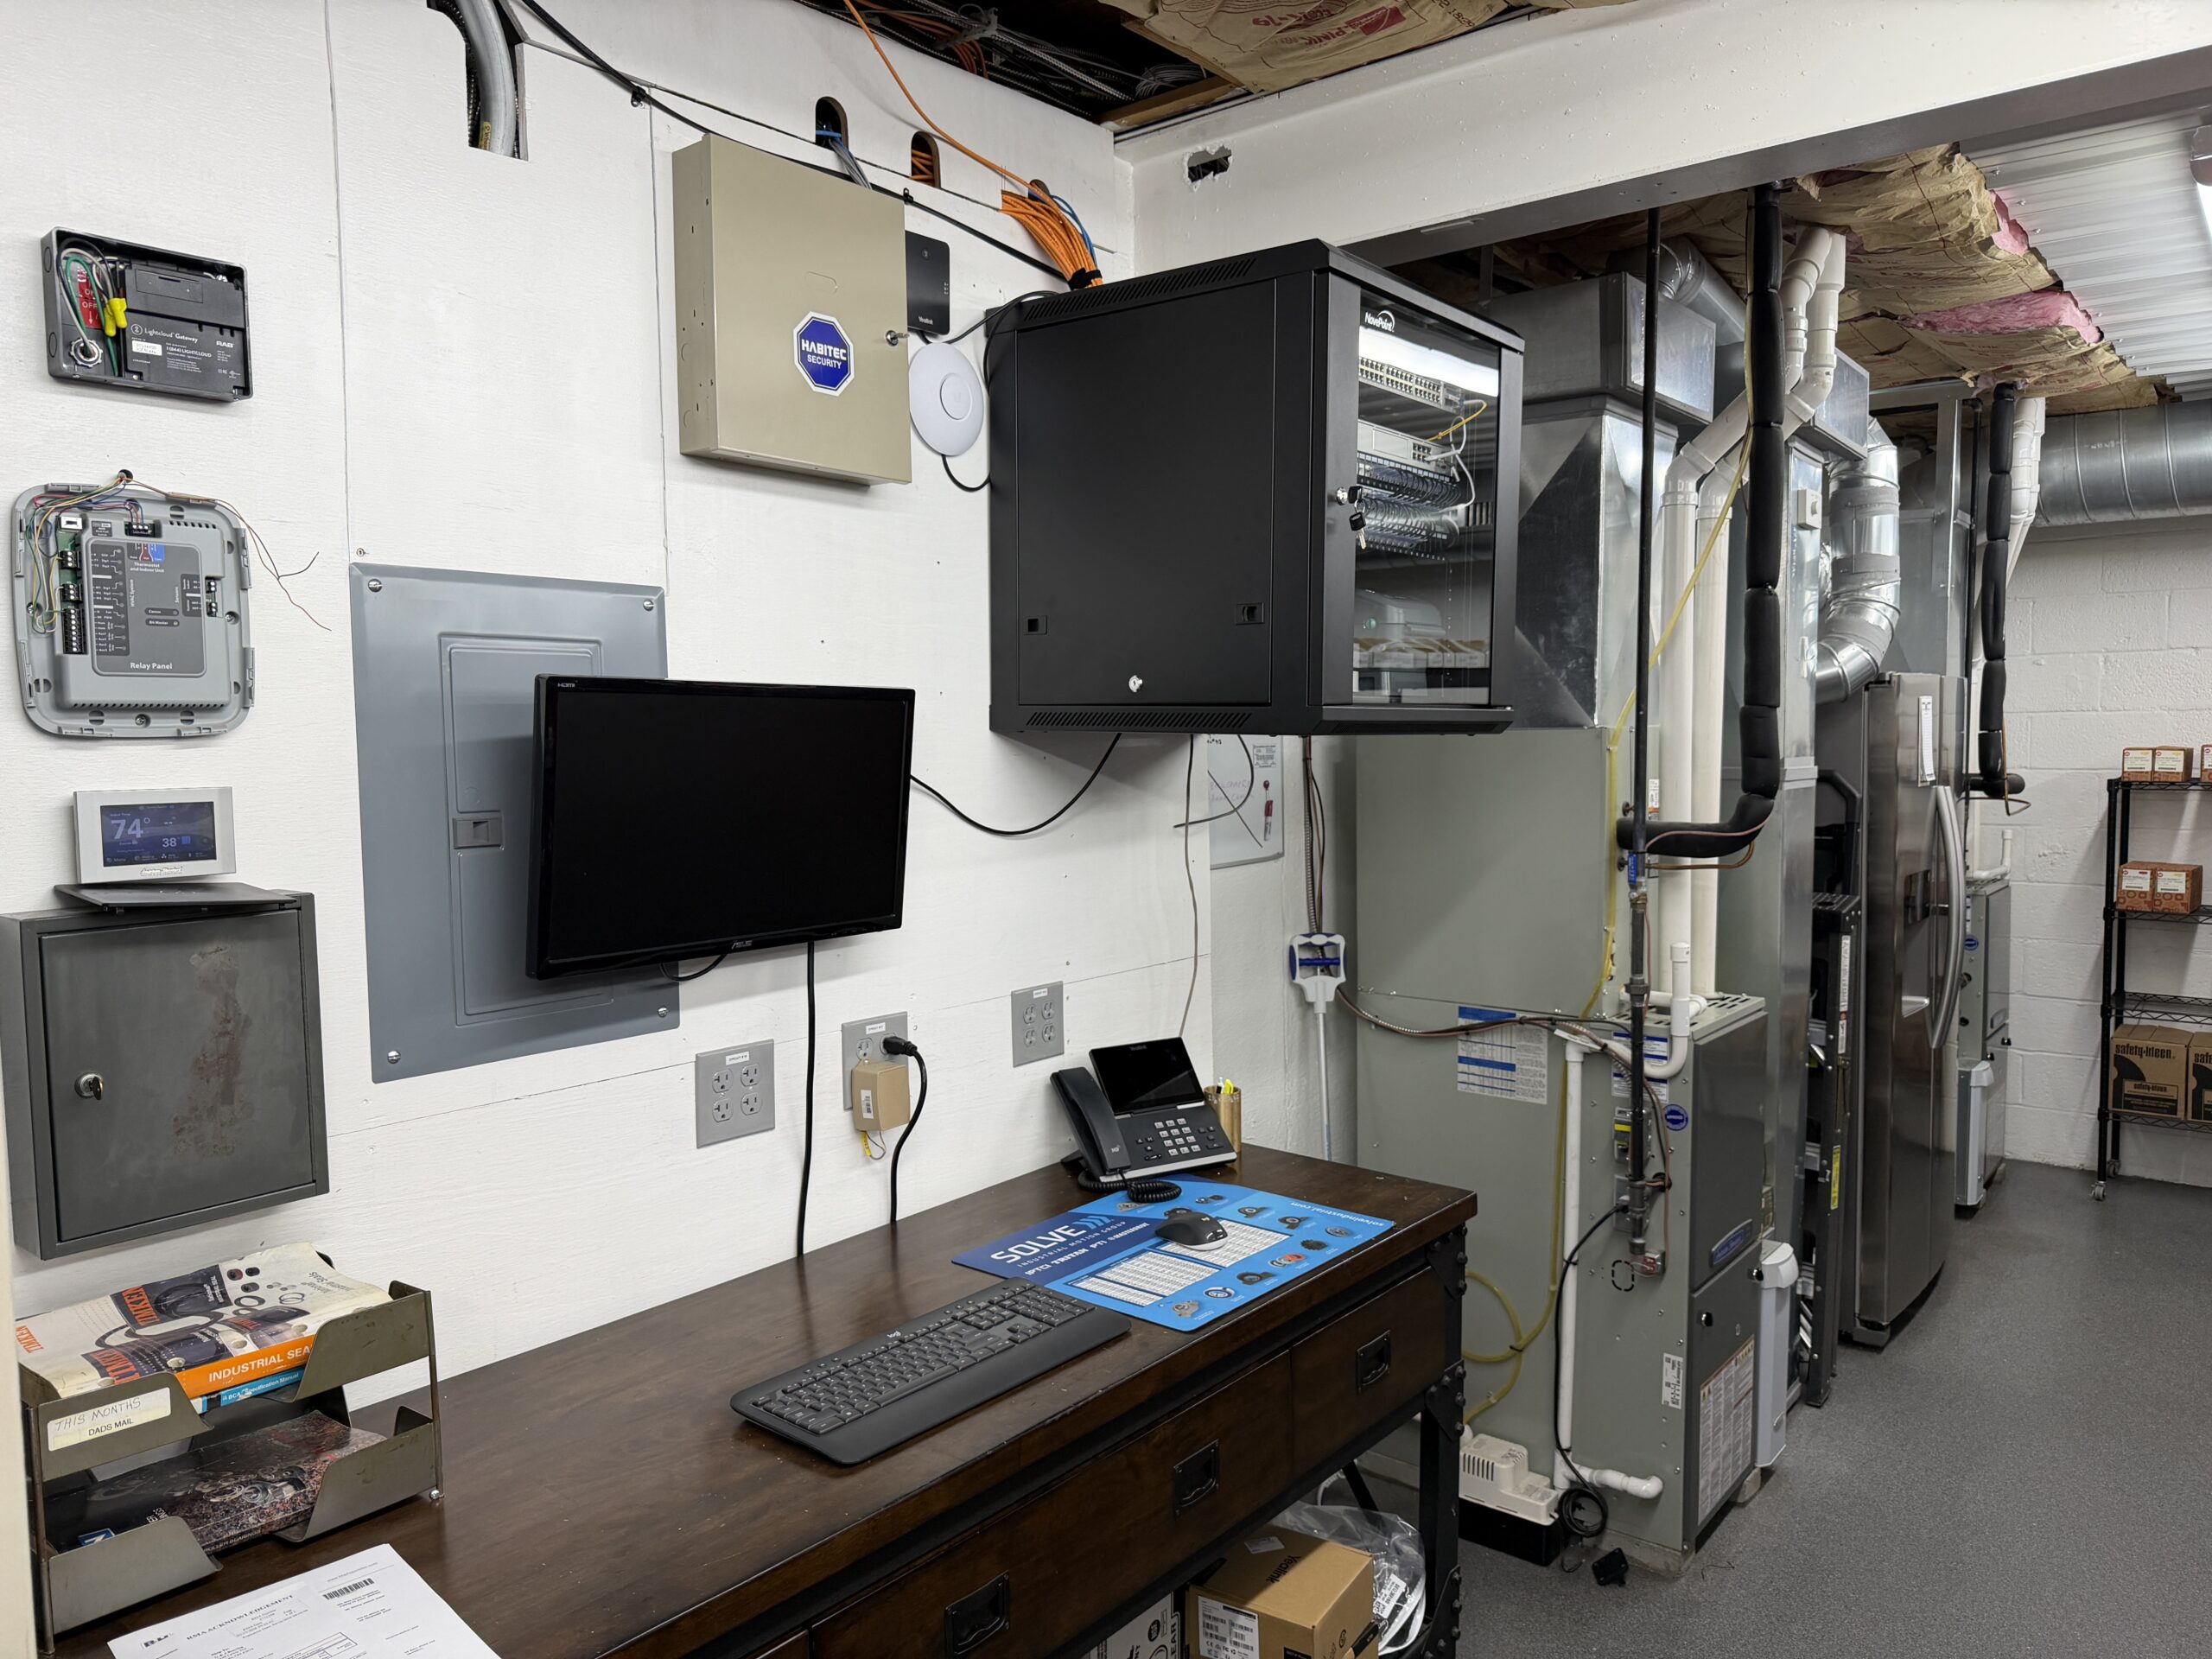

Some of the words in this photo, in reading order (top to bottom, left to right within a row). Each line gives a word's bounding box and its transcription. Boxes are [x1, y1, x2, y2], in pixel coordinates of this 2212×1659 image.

[144, 327, 174, 339] Lightcloud
[175, 333, 199, 344] Gateway
[181, 348, 212, 358] LIGHTCLOUD
[801, 339, 847, 360] HABITEC
[807, 354, 842, 369] SECURITY
[130, 662, 150, 671] Relay
[162, 837, 177, 848] 38
[1290, 1202, 1385, 1227] solveindustrial.com
[991, 1225, 1087, 1263] SOLVE
[1018, 1246, 1068, 1268] INDUSTRIAL
[1069, 1232, 1100, 1247] MOTION
[1101, 1221, 1126, 1234] GROUP
[1051, 1248, 1090, 1265] TRITAN
[1090, 1239, 1108, 1249] PTI
[121, 1286, 161, 1327] TIMKEN
[209, 1353, 284, 1383] INDUSTRIAL
[280, 1372, 299, 1383] Manual
[54, 1414, 86, 1432] THIS
[91, 1397, 141, 1422] MONTHS
[88, 1422, 113, 1437] DADS
[114, 1418, 134, 1430] MAIL
[1265, 1555, 1301, 1584] Yealink
[207, 1594, 294, 1632] ACKNOWLEDGEMENT
